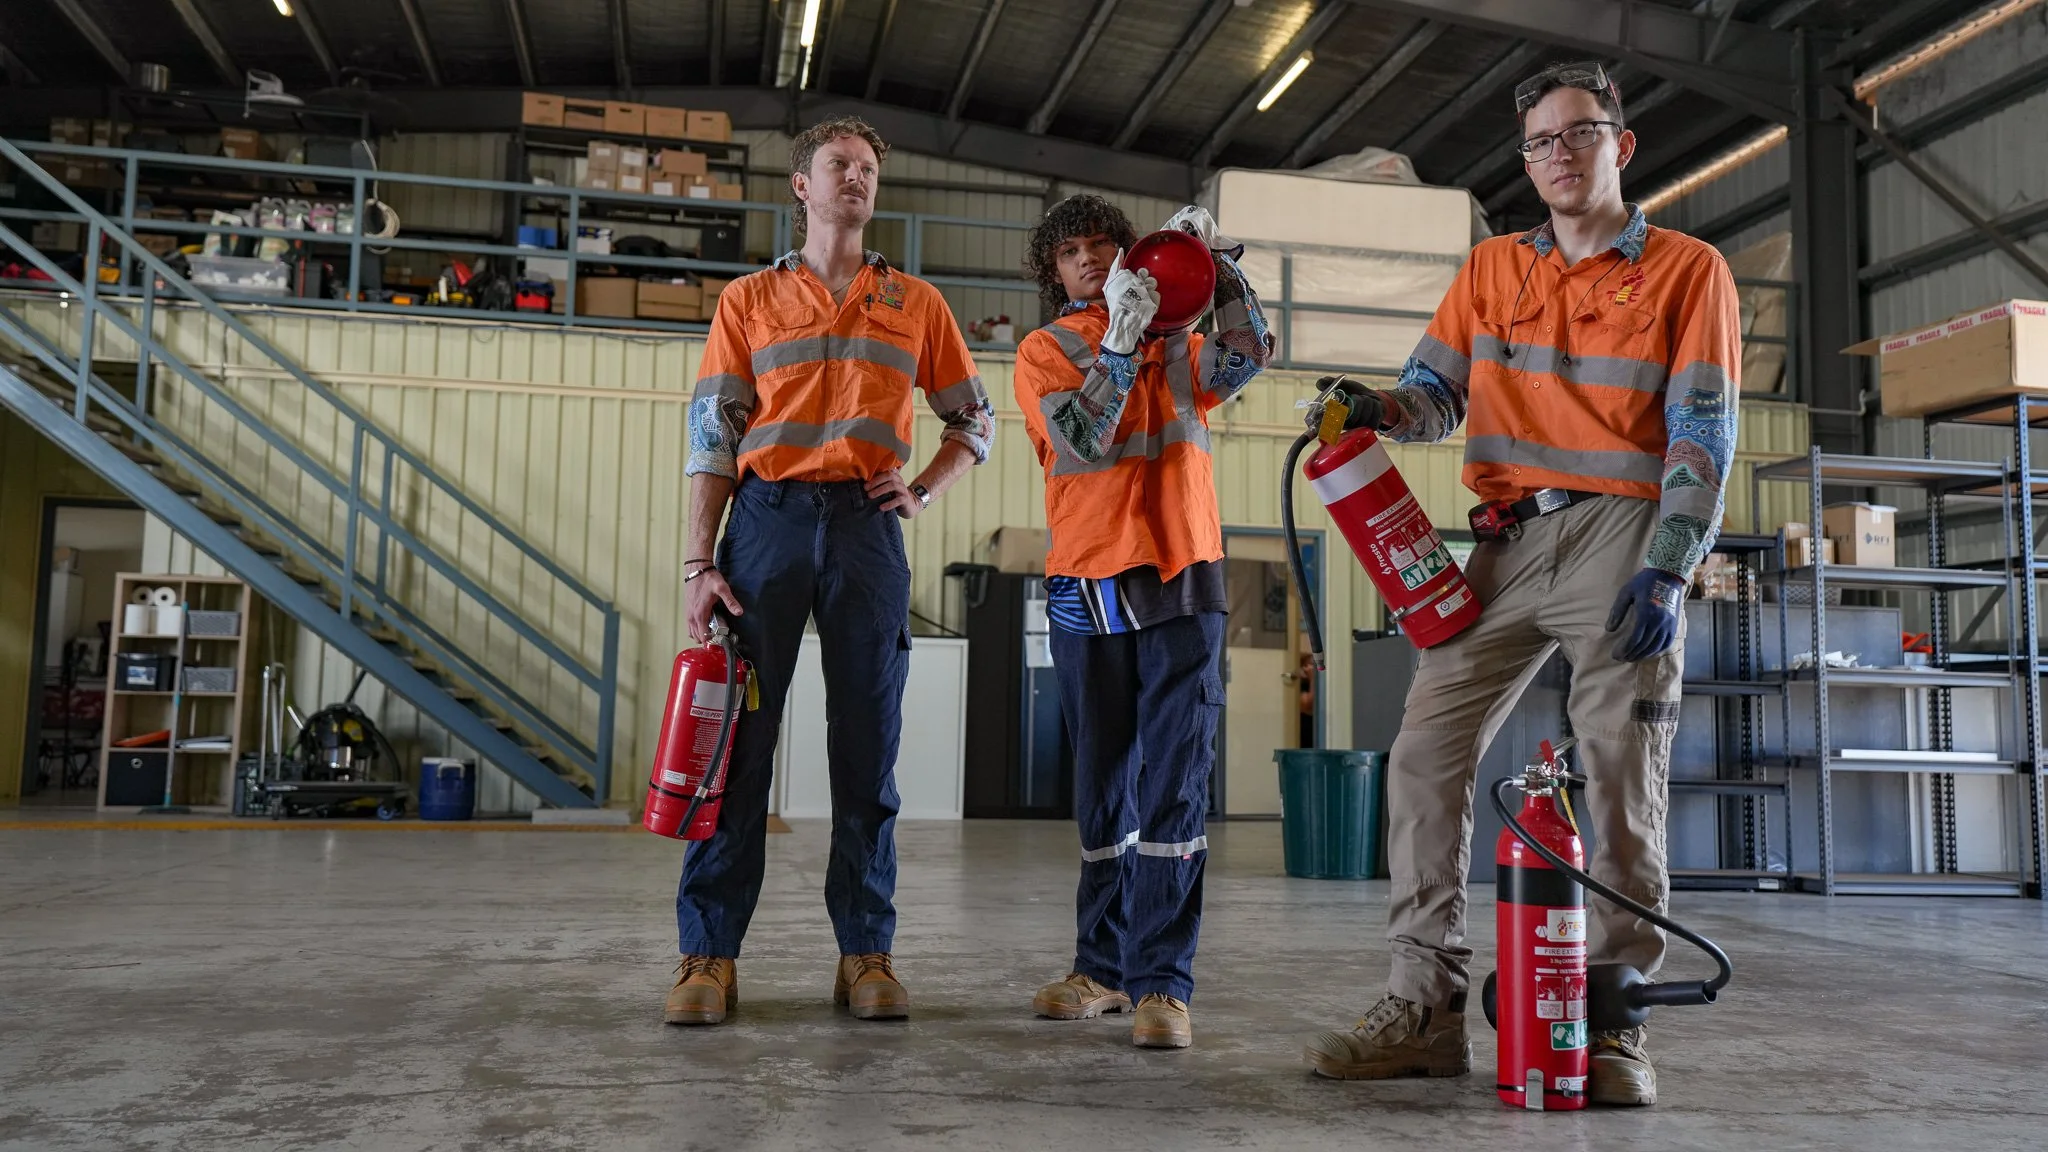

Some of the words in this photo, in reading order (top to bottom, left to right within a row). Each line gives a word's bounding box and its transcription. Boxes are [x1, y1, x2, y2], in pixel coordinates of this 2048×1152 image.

[1980, 306, 2008, 322] FRAGILE
[2018, 305, 2047, 316] FRAGILE
[1947, 318, 1974, 332] FRAGILE
[1916, 329, 1941, 343] FRAGILE
[1885, 338, 1910, 351] FRAGILE
[1370, 543, 1388, 567] Presto
